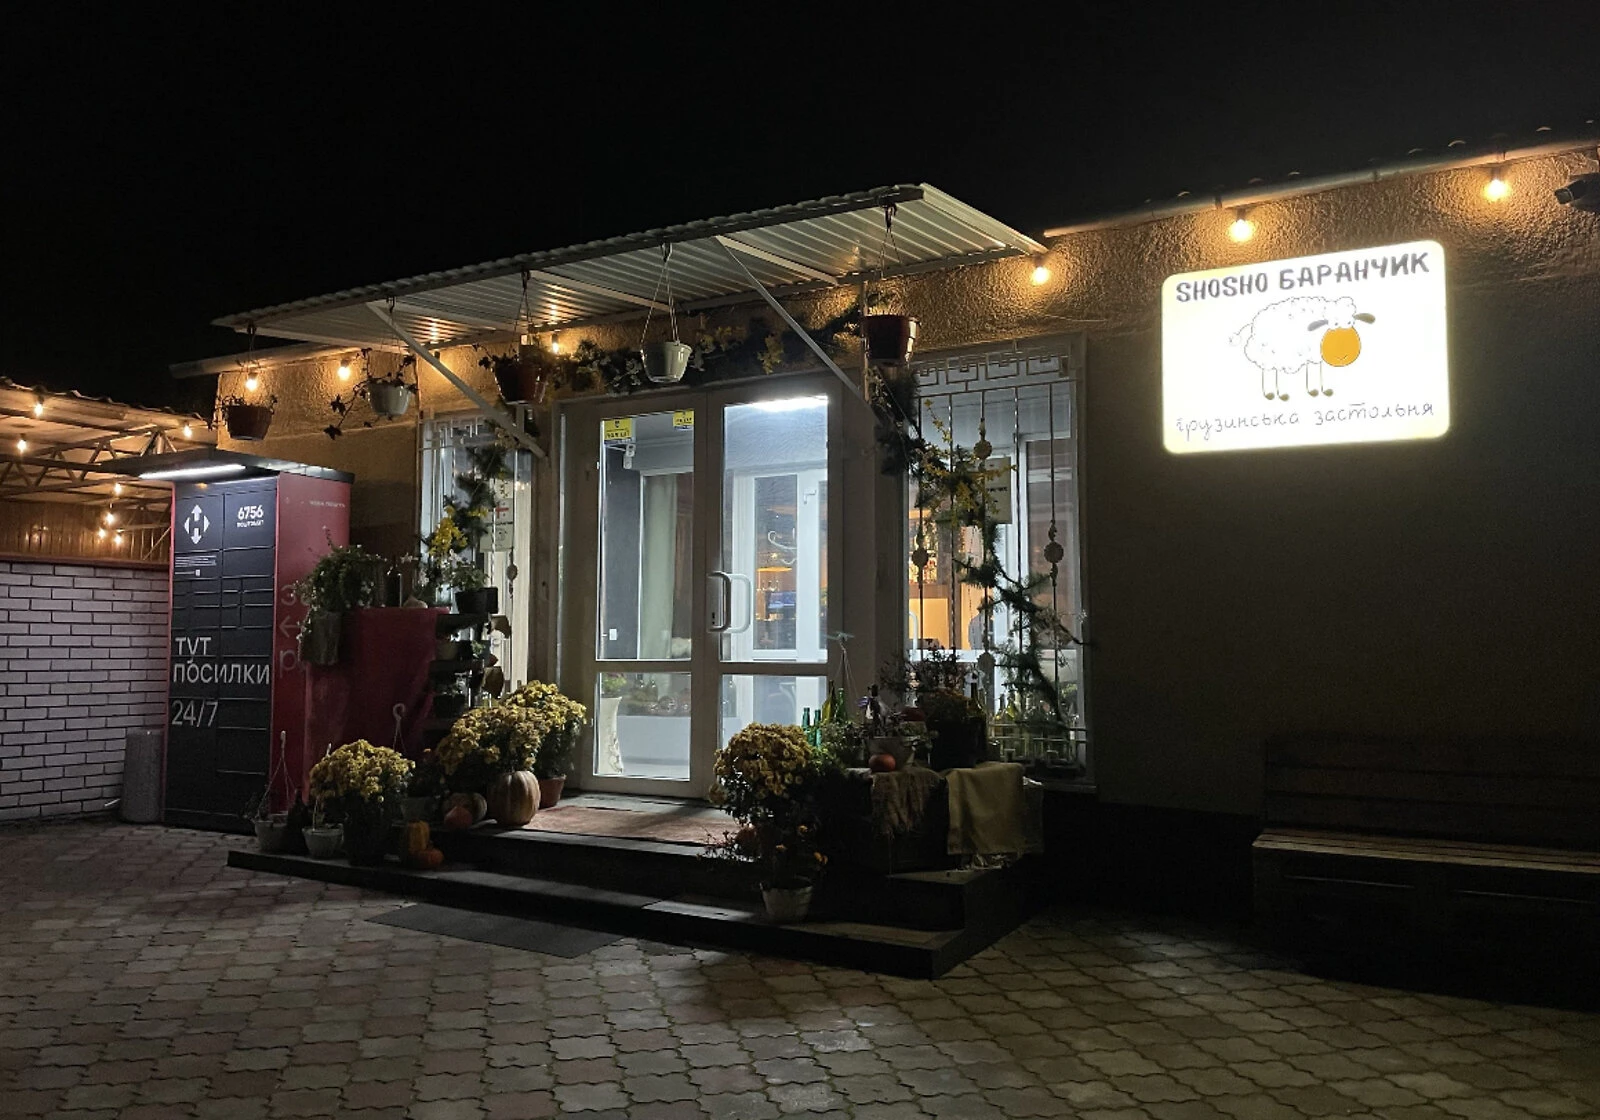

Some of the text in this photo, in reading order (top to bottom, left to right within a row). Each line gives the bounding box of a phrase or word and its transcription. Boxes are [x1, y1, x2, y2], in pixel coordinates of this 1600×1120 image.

[1175, 251, 1431, 303] SHOSHO БАРАНЧИК
[1314, 402, 1435, 427] застольня
[237, 504, 265, 520] 6756
[174, 636, 213, 664] ТУТ
[172, 662, 271, 686] ПОСИЛКИ
[171, 699, 220, 728] 24/7
